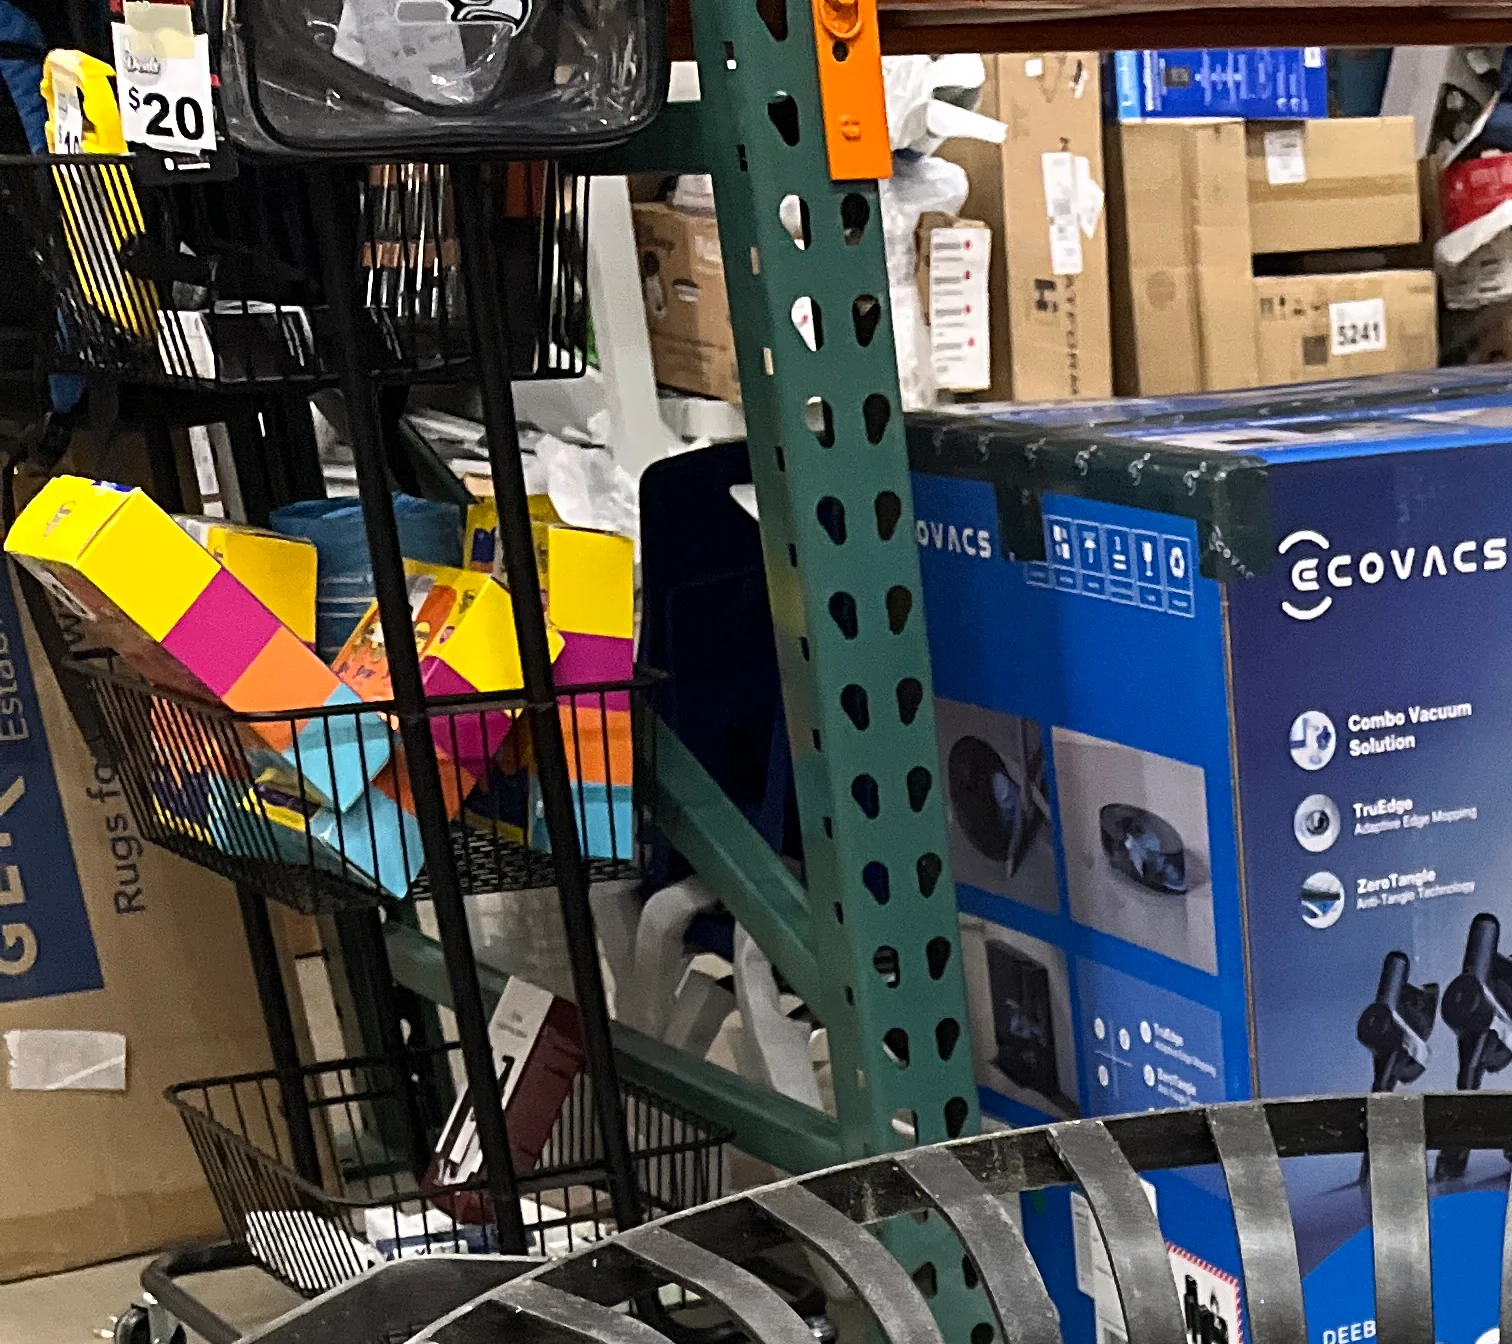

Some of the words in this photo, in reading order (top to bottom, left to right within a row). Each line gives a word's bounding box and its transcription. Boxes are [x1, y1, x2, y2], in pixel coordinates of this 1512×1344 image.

[128, 86, 205, 141] $20
[916, 520, 992, 560] OVACS
[1290, 537, 1508, 592] ECOVACS
[1347, 710, 1406, 732] Combo
[1408, 702, 1473, 724] Vacuum
[1349, 734, 1416, 757] Solution
[1352, 796, 1414, 819] TruEdge
[106, 813, 145, 915] Rugs
[1356, 867, 1437, 895] ZeroTangle
